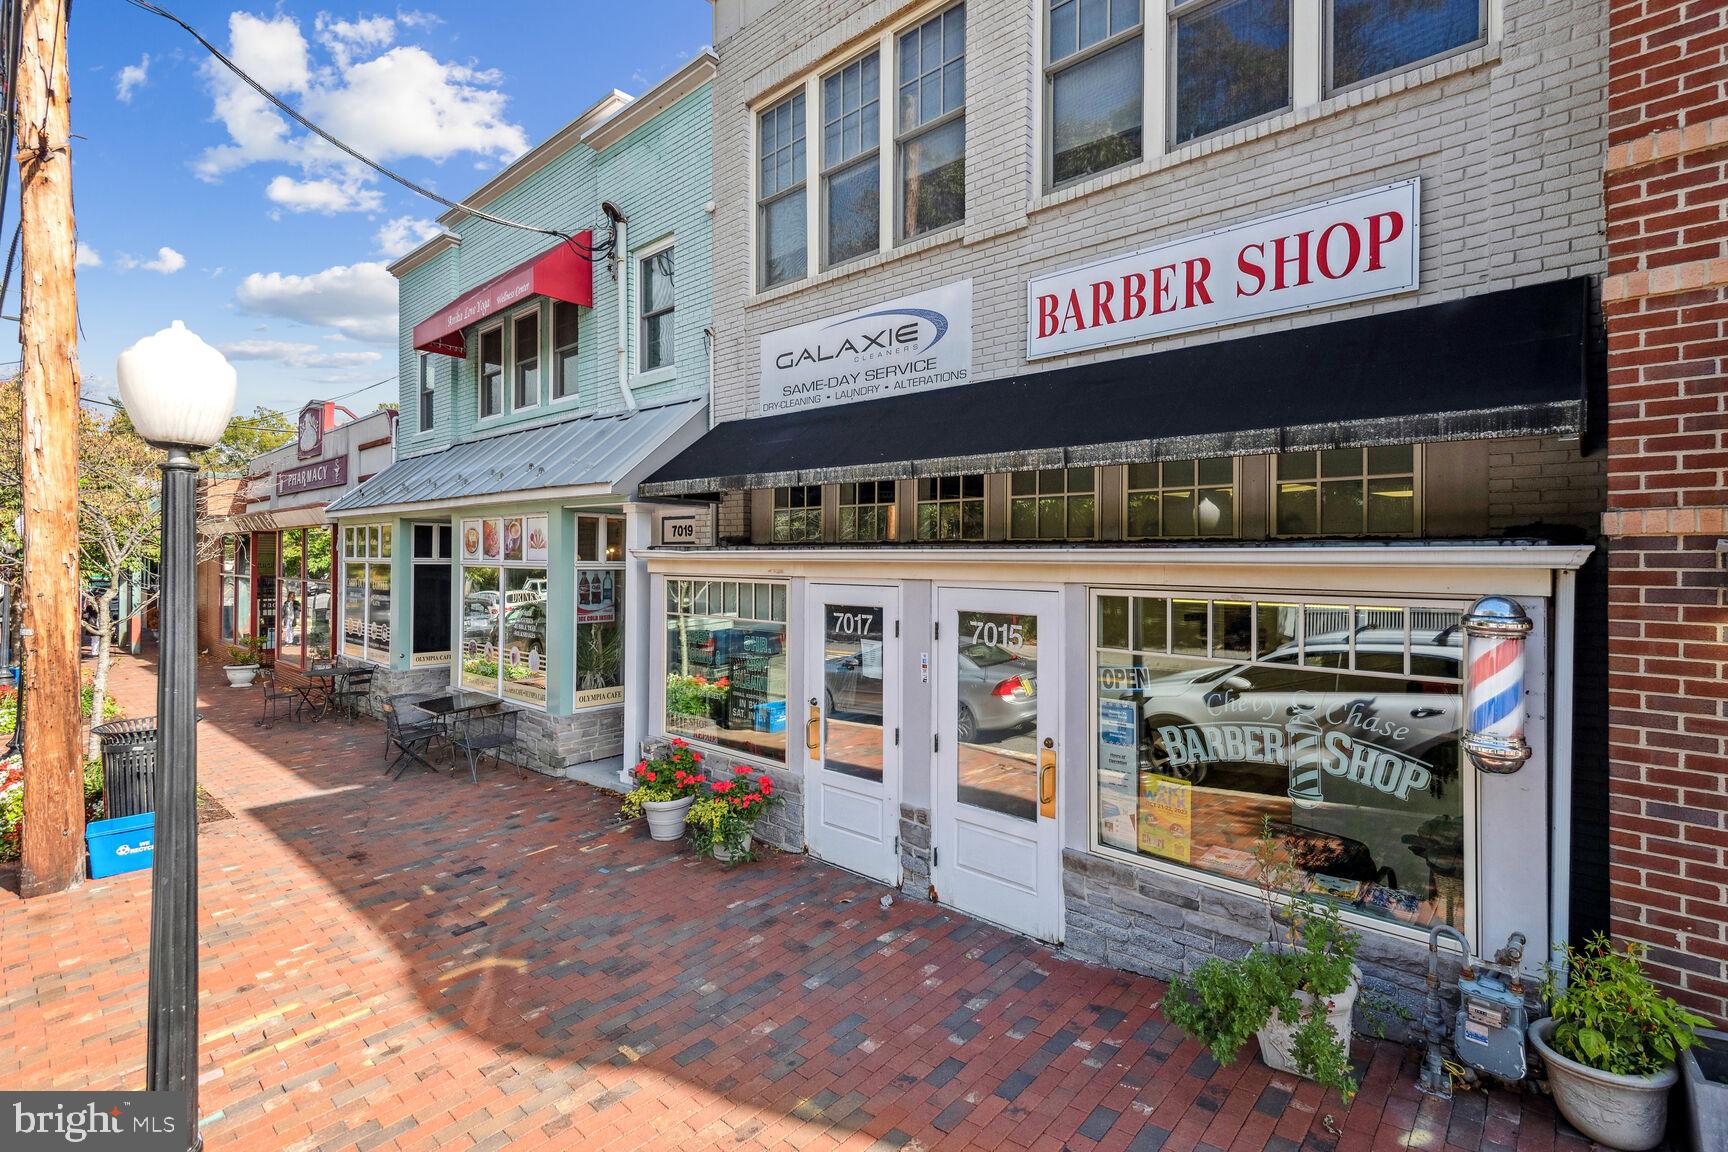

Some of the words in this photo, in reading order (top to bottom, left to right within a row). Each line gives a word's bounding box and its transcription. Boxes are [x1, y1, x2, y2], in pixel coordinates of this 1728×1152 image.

[1036, 256, 1214, 339] BARBER
[1236, 211, 1404, 298] SHOP
[776, 322, 919, 370] GALAXIE
[854, 343, 919, 363] CLEANERS
[782, 371, 861, 397] SAME-DAY
[865, 357, 937, 382] SERVICE
[762, 394, 821, 412] DRY-CLEANING
[835, 384, 880, 400] LAUNDRY
[894, 369, 967, 390] ALTERATIONS
[287, 465, 328, 487] PHARMACY
[672, 525, 694, 537] 7019
[833, 612, 873, 635] 7017
[970, 620, 1024, 650] 7015
[1102, 667, 1149, 690] OPEN
[578, 692, 606, 703] OLYMPIA
[606, 691, 622, 700] CAFE
[732, 708, 747, 719] SAT.
[1206, 690, 1280, 720] Chevy
[1325, 702, 1410, 741] Chase
[1158, 725, 1288, 768] BARBER
[1323, 731, 1432, 802] SHOP
